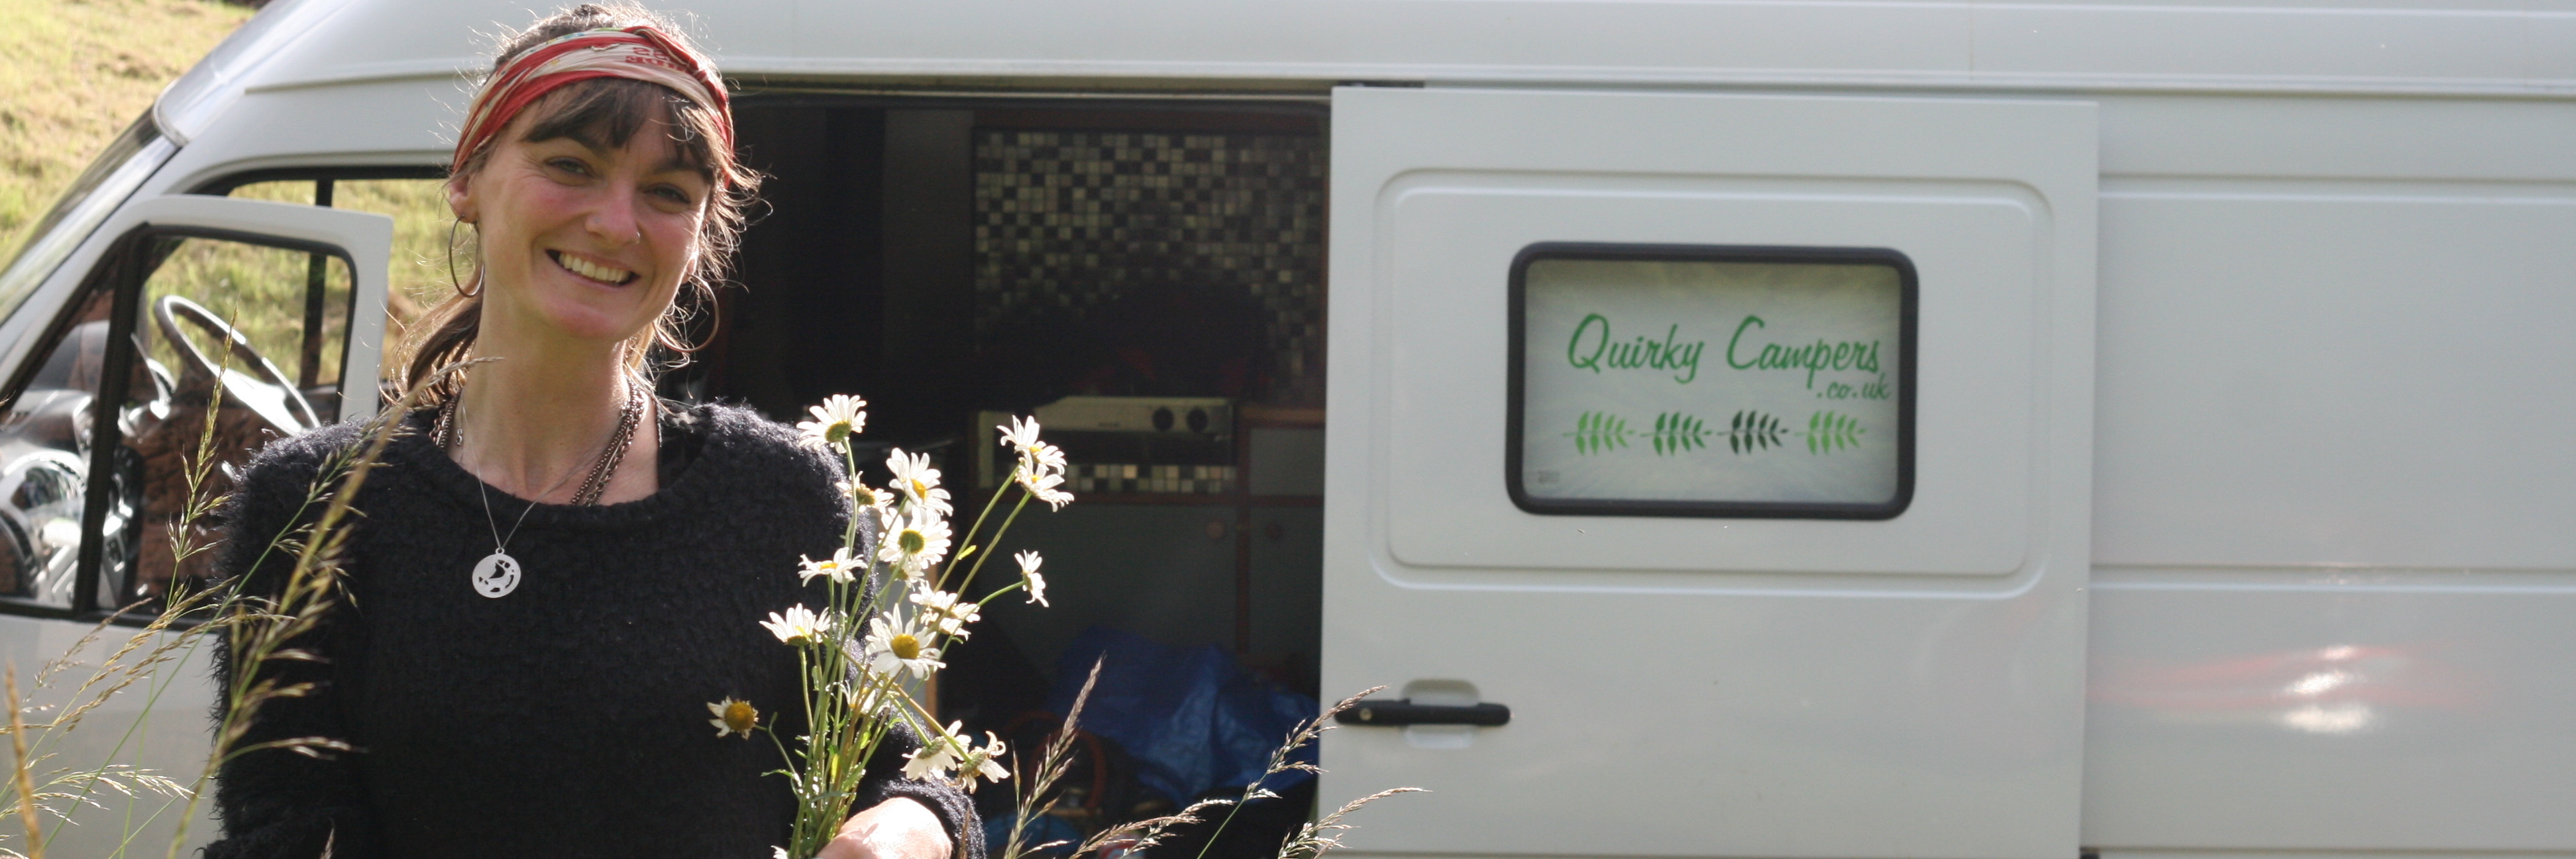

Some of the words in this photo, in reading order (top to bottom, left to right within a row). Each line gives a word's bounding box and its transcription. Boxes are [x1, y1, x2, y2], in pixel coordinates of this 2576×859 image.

[1568, 313, 1705, 384] Quirky
[1727, 315, 1880, 389] Campers
[1817, 372, 1891, 399] .co.uk
